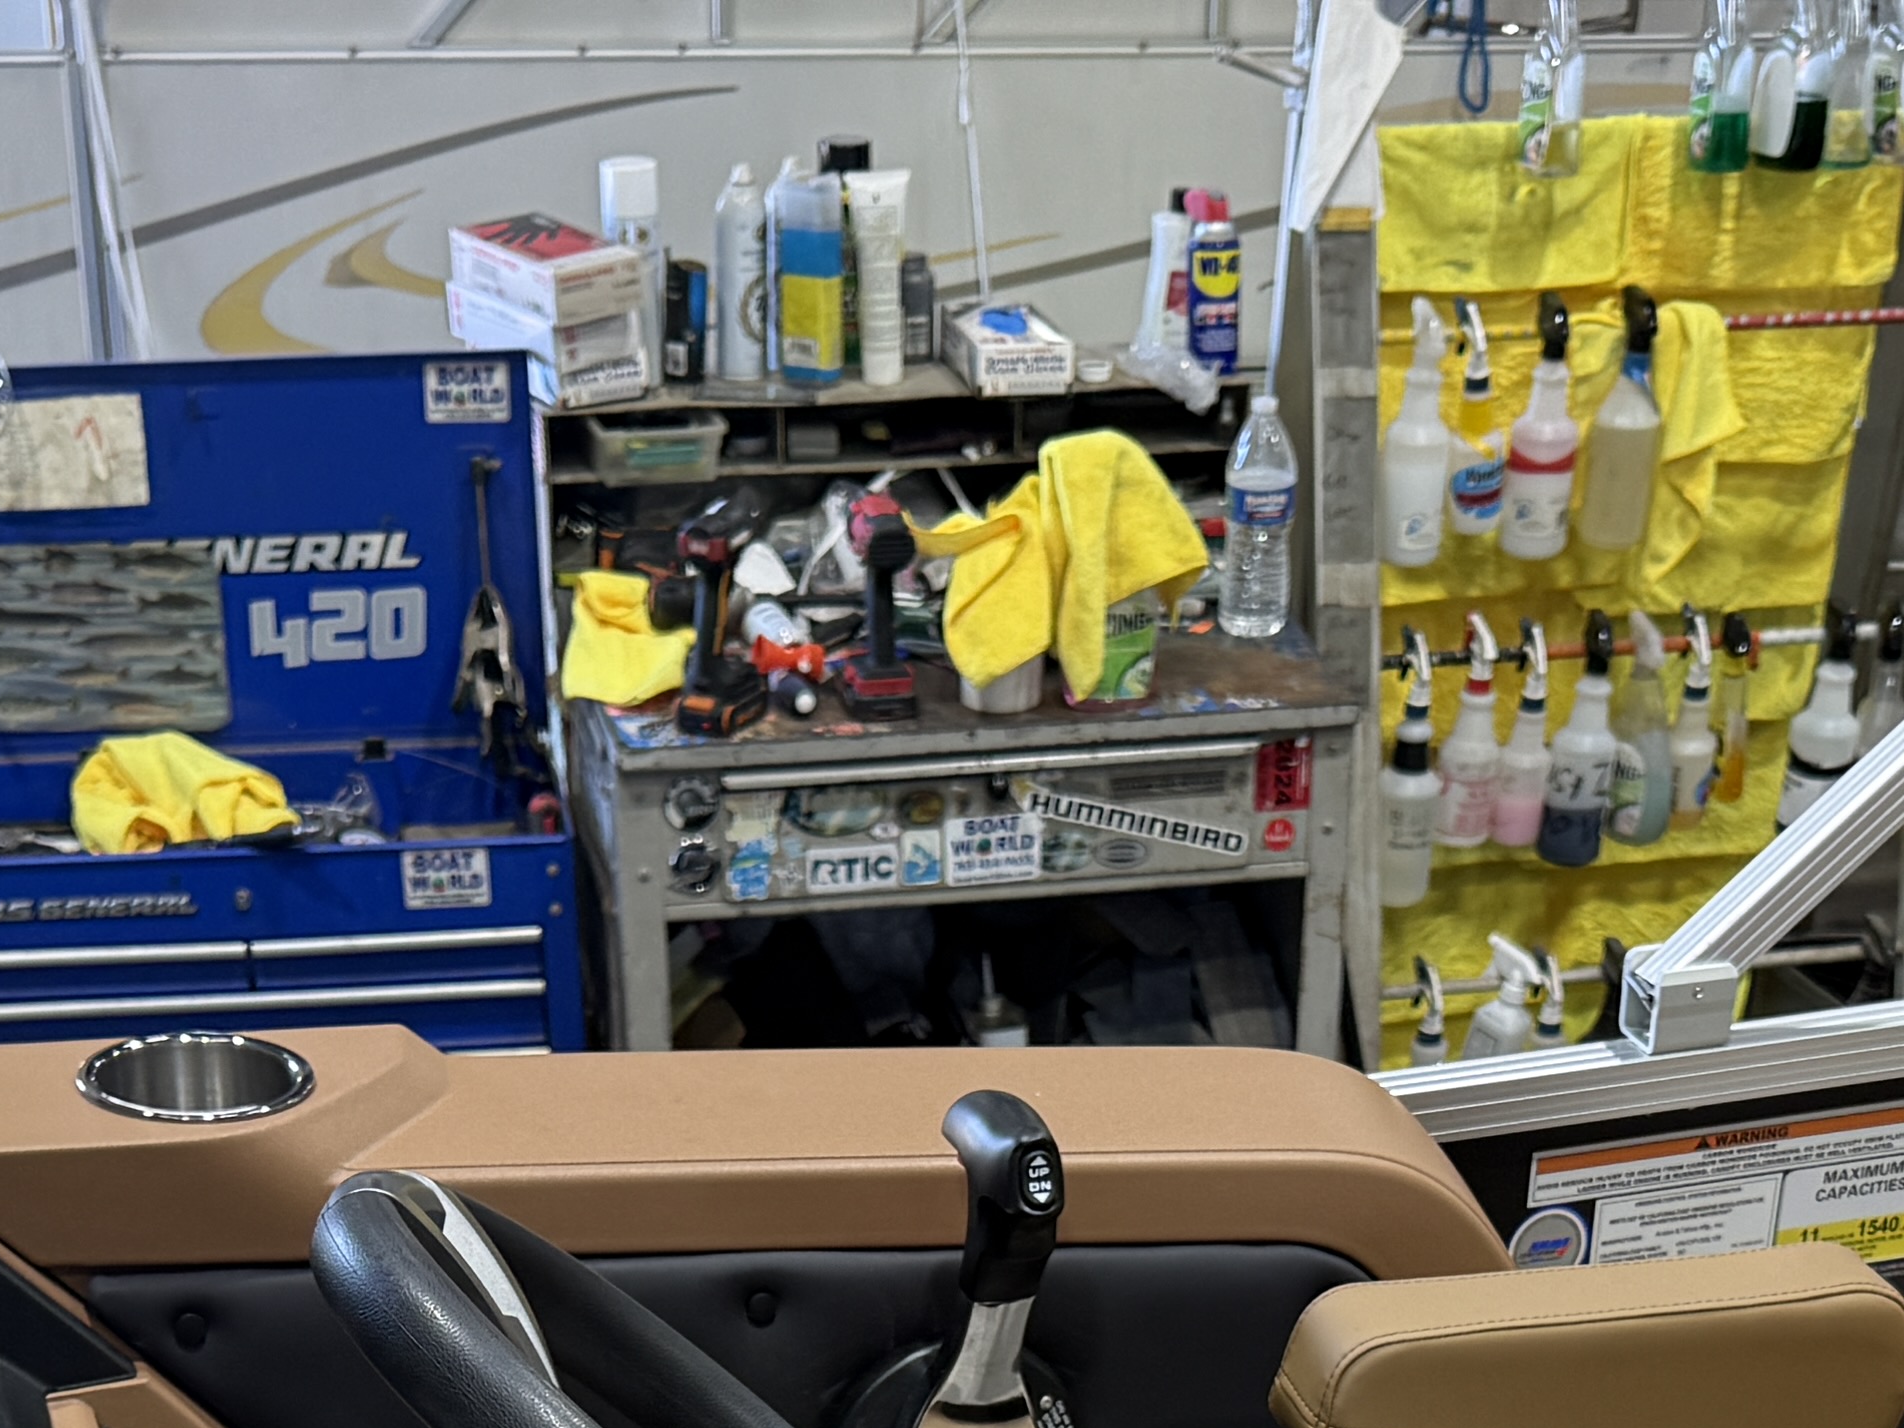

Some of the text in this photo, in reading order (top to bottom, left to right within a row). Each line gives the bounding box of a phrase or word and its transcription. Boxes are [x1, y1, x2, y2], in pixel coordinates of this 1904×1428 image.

[248, 585, 428, 669] 420
[963, 816, 1020, 836] BOAT
[1030, 793, 1243, 853] HUMMINBIRD
[810, 855, 895, 886] RTIC
[38, 893, 199, 920] GENERAL
[1715, 1126, 1789, 1147] WARNING
[1028, 1166, 1050, 1178] UP
[1028, 1180, 1052, 1193] DN
[1800, 1227, 1819, 1242] 11
[1857, 1216, 1900, 1237] 1540
